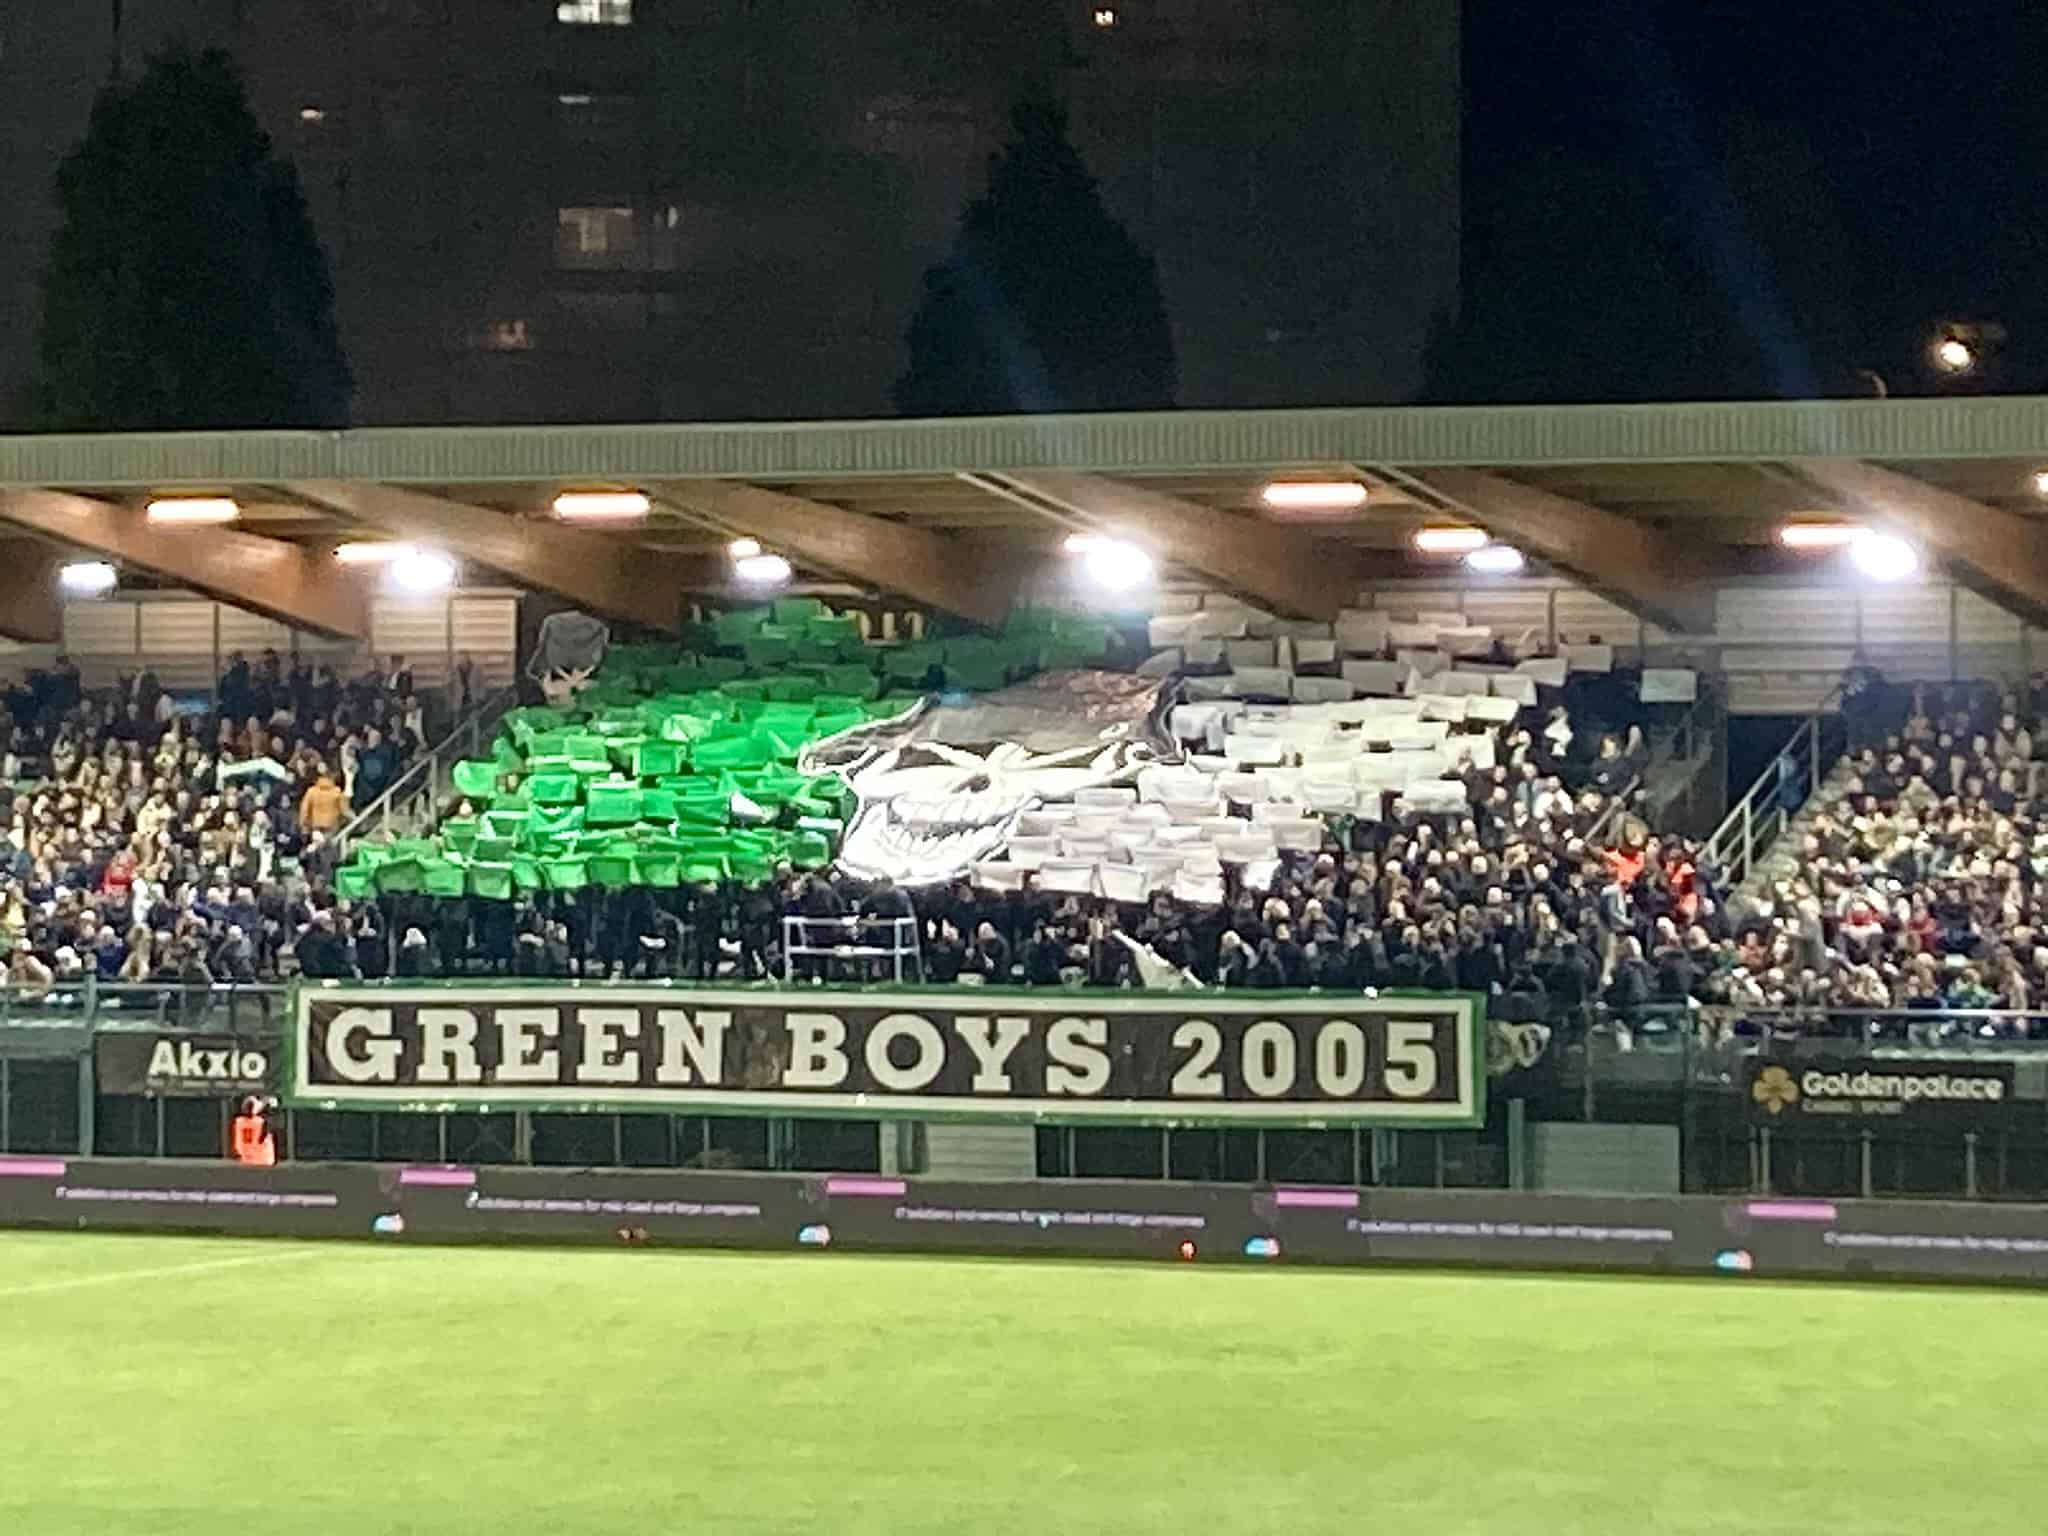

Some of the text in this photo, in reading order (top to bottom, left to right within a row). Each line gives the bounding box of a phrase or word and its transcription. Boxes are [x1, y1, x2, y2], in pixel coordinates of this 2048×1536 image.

[325, 1007, 1437, 1097] GREEN BOYS 2005
[1801, 1070, 2004, 1101] Goldenpalace
